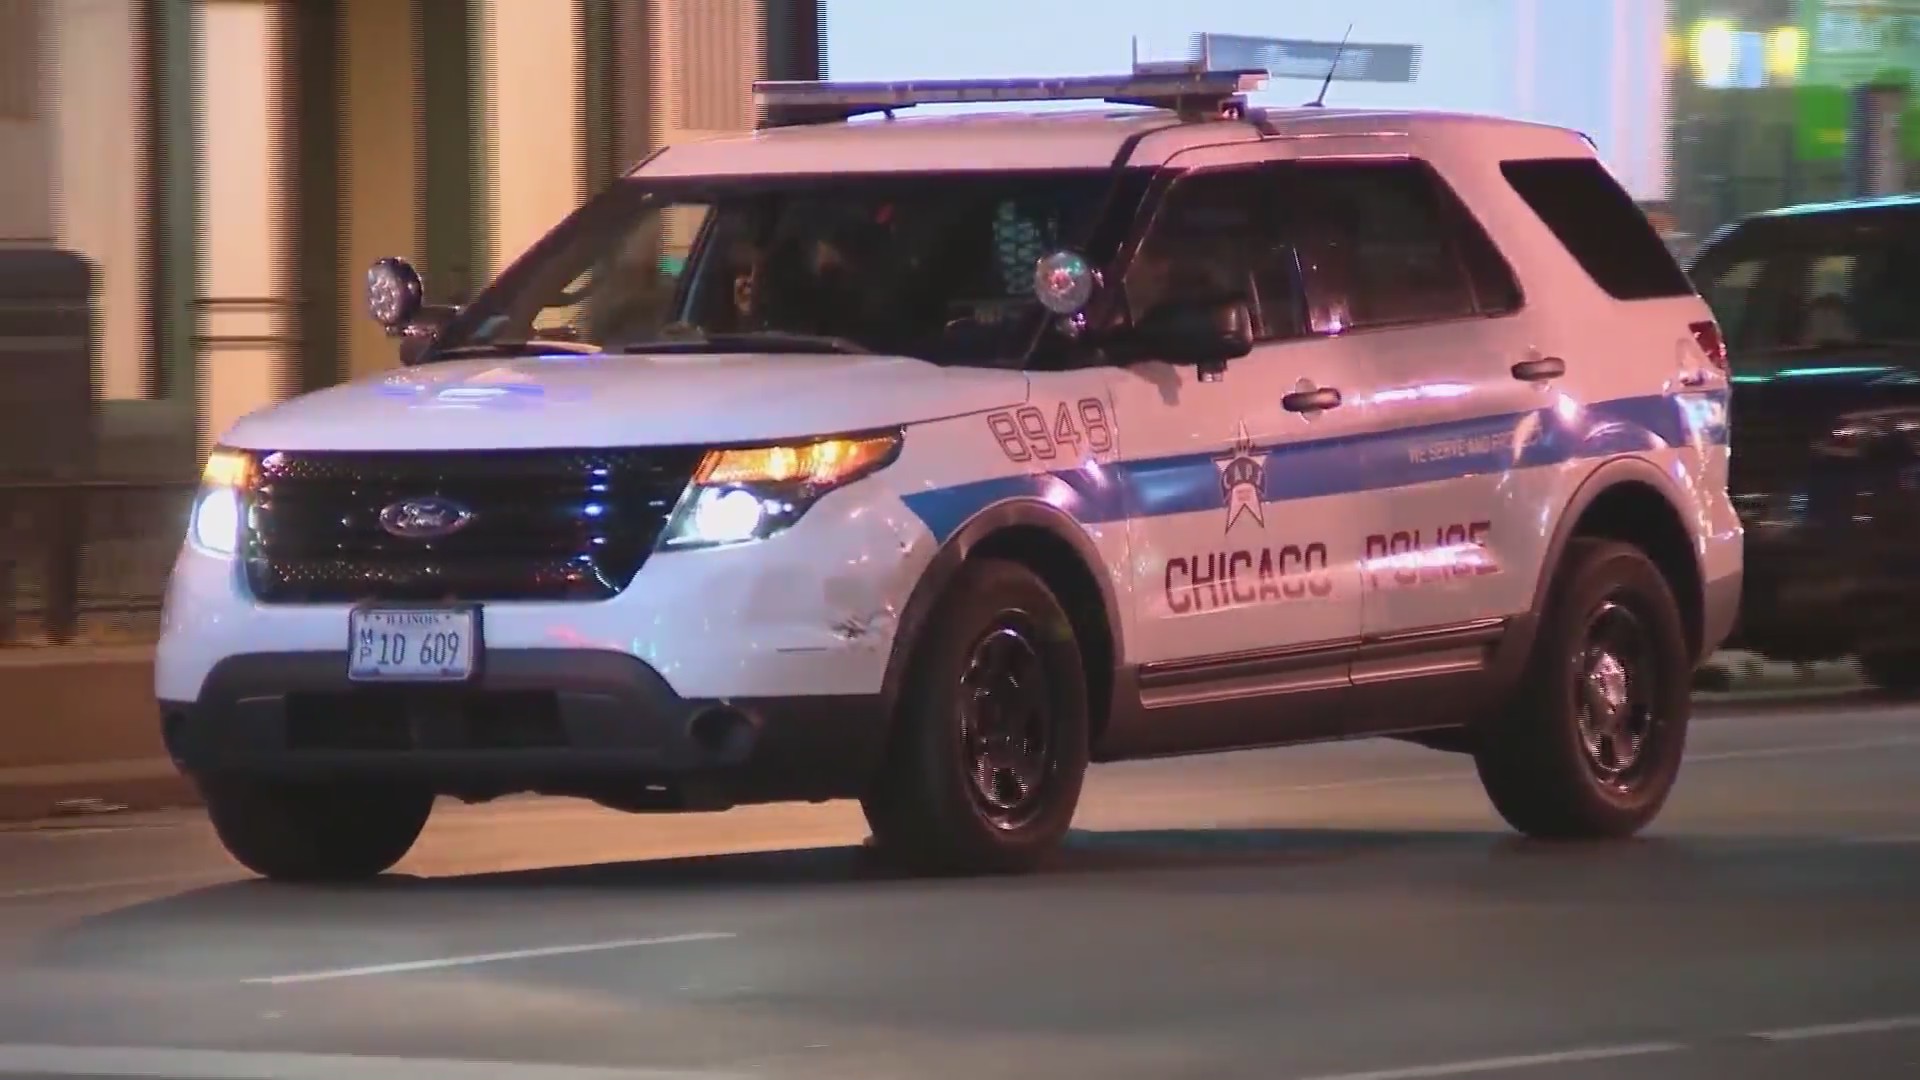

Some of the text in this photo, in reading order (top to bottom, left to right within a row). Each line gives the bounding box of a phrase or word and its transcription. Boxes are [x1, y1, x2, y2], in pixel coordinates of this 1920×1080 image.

[987, 397, 1112, 462] 8948
[1408, 447, 1427, 464] WE
[396, 501, 447, 528] Ford
[1366, 520, 1499, 590] POLICE
[386, 614, 440, 625] ILLINOIS
[377, 631, 459, 666] 10 609
